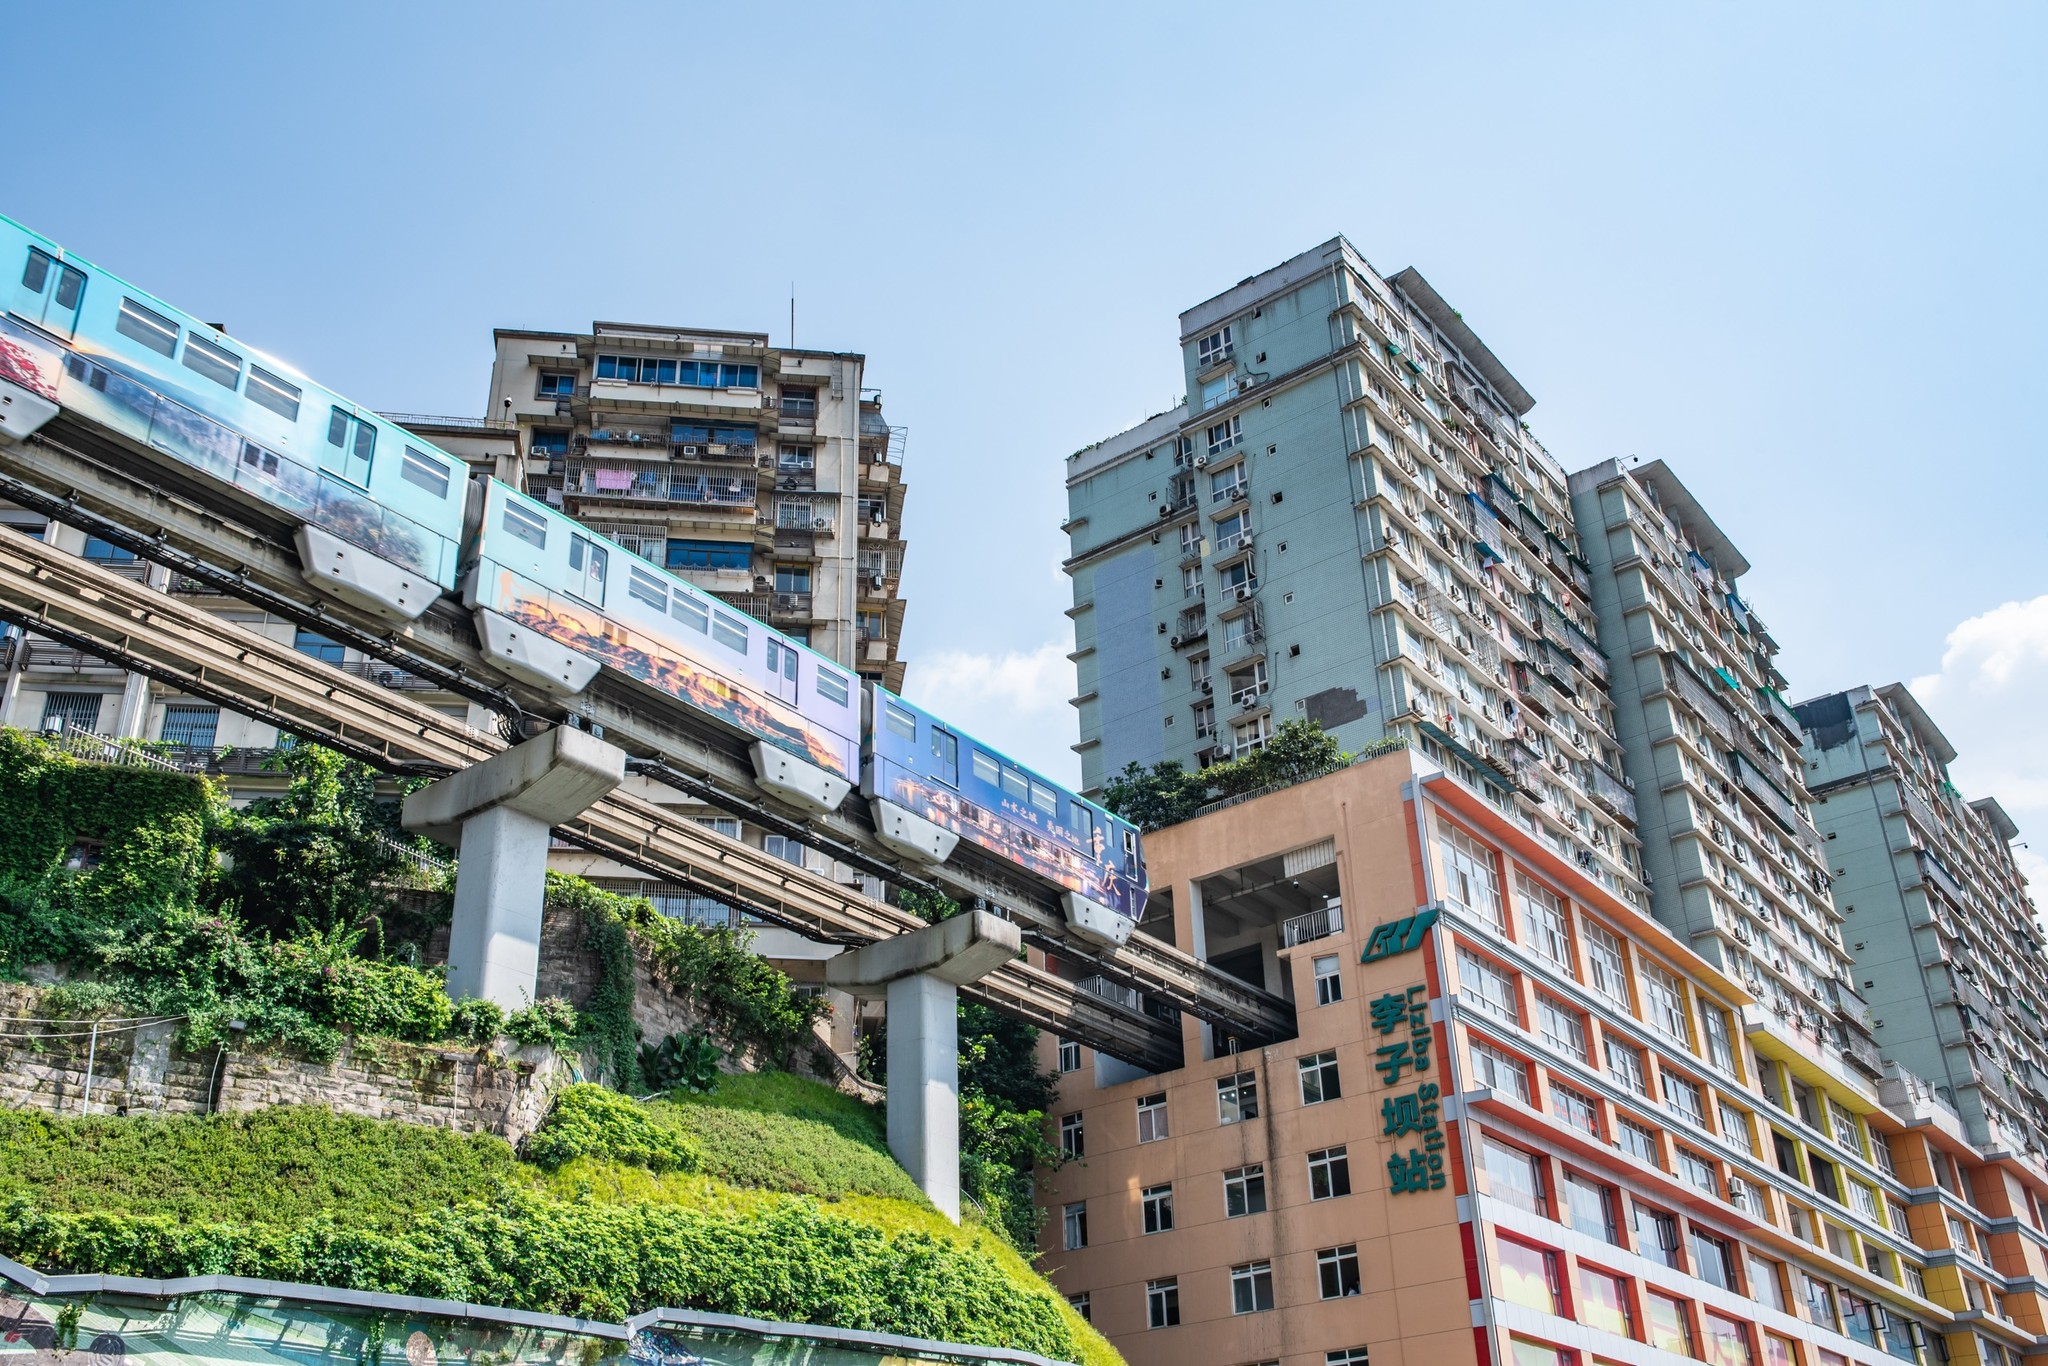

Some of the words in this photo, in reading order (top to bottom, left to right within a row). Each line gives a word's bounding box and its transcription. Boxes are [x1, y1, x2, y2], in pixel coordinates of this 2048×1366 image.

[1001, 798, 1038, 825] 山水之城
[1086, 826, 1121, 896] 重庆
[1407, 985, 1432, 1072] Liziba
[1370, 993, 1430, 1194] 李子坝站
[1418, 1082, 1446, 1190] Station
